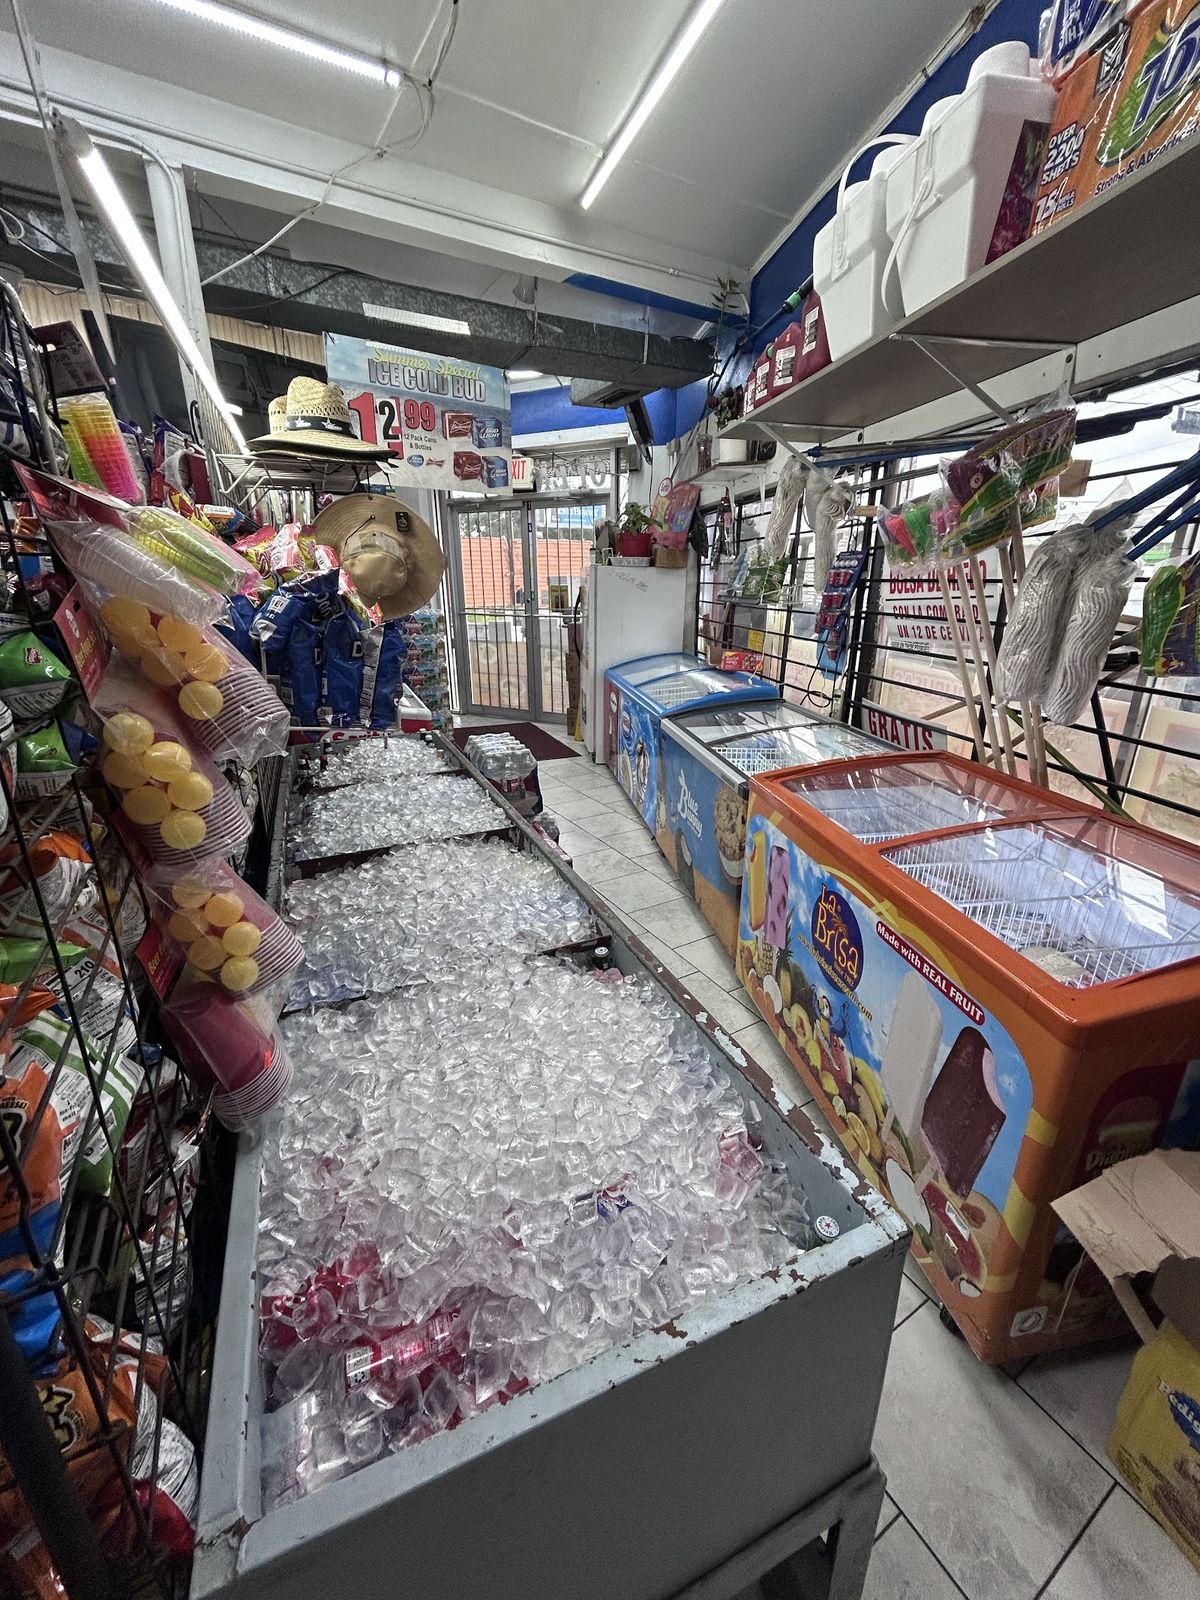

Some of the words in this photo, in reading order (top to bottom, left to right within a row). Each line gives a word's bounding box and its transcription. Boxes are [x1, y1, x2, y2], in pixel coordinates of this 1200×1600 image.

[1043, 127, 1085, 171] 2200
[1048, 122, 1077, 149] OVER
[1040, 151, 1081, 185] SHEETS
[1094, 169, 1126, 196] Strong
[1126, 159, 1136, 175] &
[1035, 186, 1061, 224] 15
[368, 358, 401, 388] ICE
[403, 365, 449, 396] COLD
[451, 374, 487, 403] BUD
[373, 348, 430, 370] Summer
[436, 359, 481, 381] Special
[410, 433, 423, 442] Pack
[423, 435, 437, 444] Cans
[414, 442, 432, 451] Bottles
[512, 460, 526, 480] XIT
[893, 605, 909, 620] CON
[897, 624, 910, 639] UN
[911, 625, 923, 639] 12
[925, 625, 938, 640] DE
[868, 709, 934, 751] GRATIS
[821, 885, 837, 913] La
[815, 902, 859, 979] Brisa
[74, 960, 95, 979] 210
[877, 923, 900, 950] Made
[901, 945, 921, 969] with
[922, 963, 948, 993] REAL
[949, 987, 983, 1022] FRUIT
